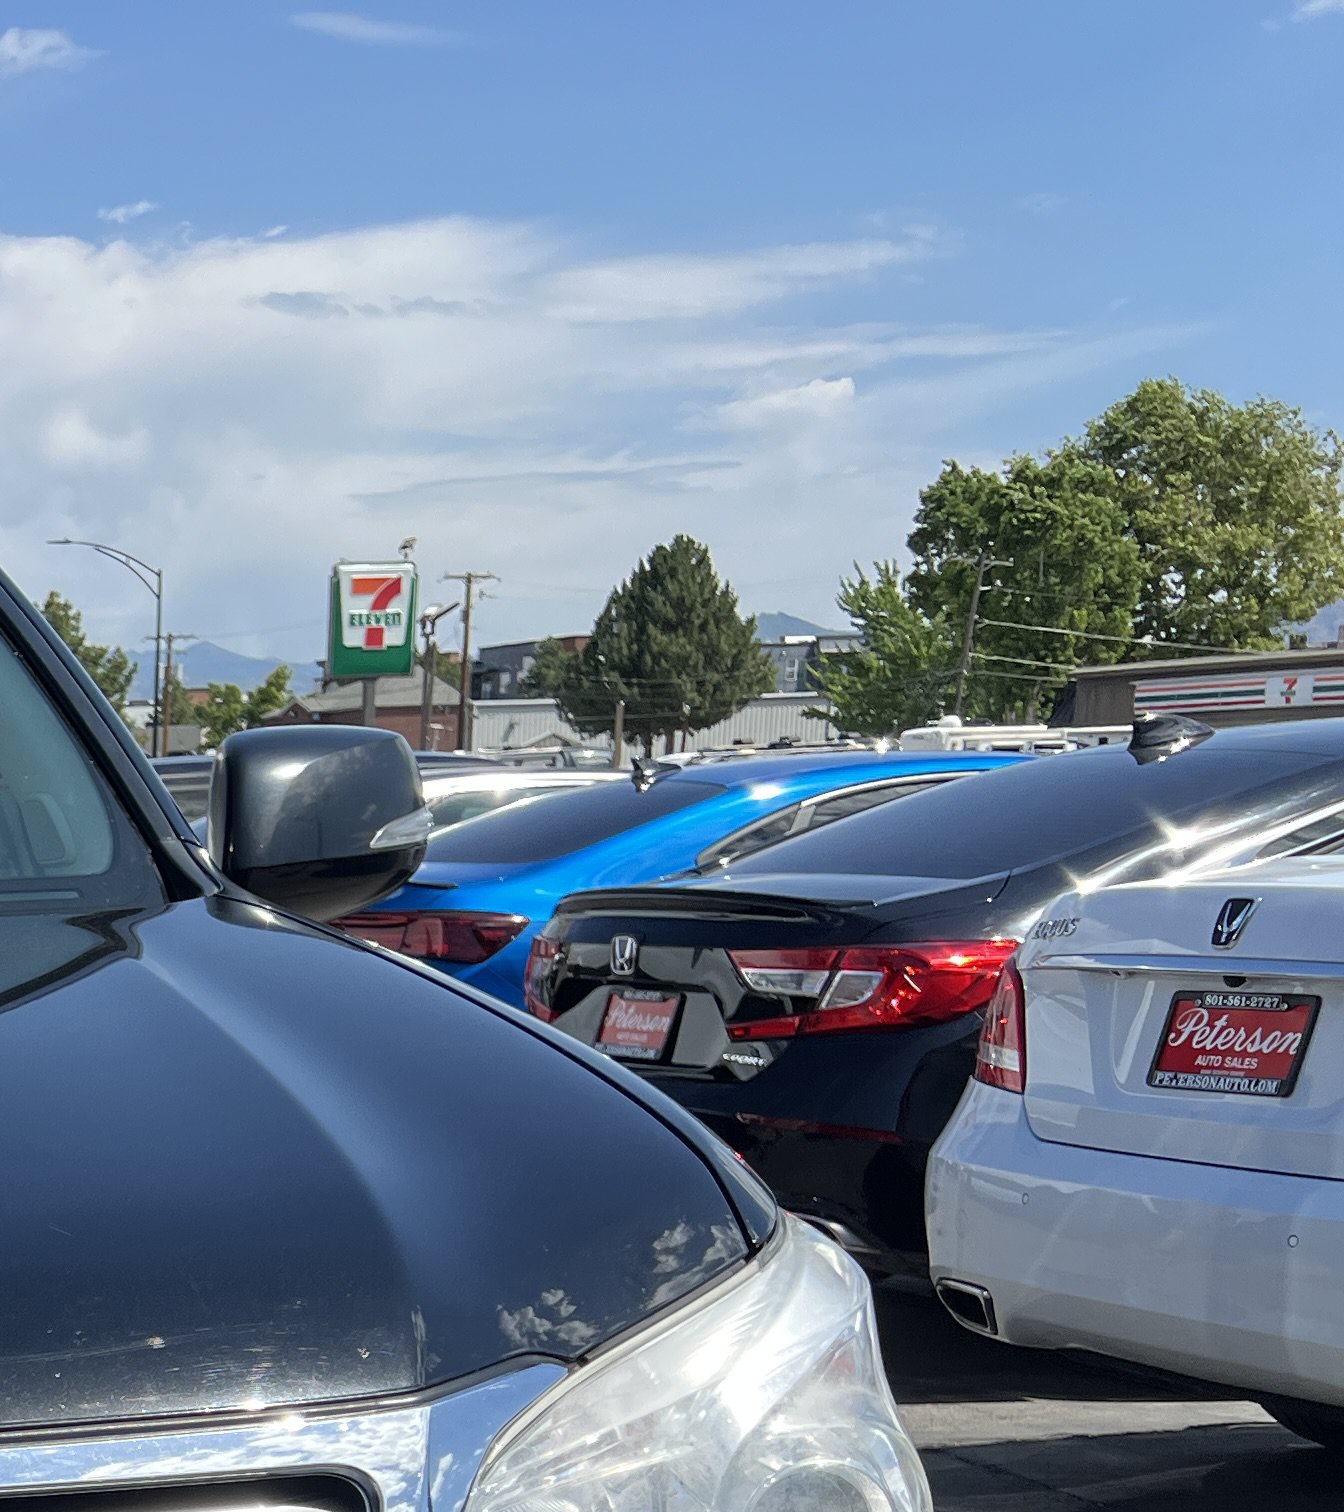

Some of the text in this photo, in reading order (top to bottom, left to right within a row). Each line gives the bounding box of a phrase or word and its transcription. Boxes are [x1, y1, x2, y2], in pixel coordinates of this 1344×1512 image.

[351, 577, 402, 647] 7
[1204, 994, 1280, 1009] 801-561-2727
[1168, 1007, 1302, 1055] Peterson
[1195, 1054, 1258, 1070] AUTO SALES
